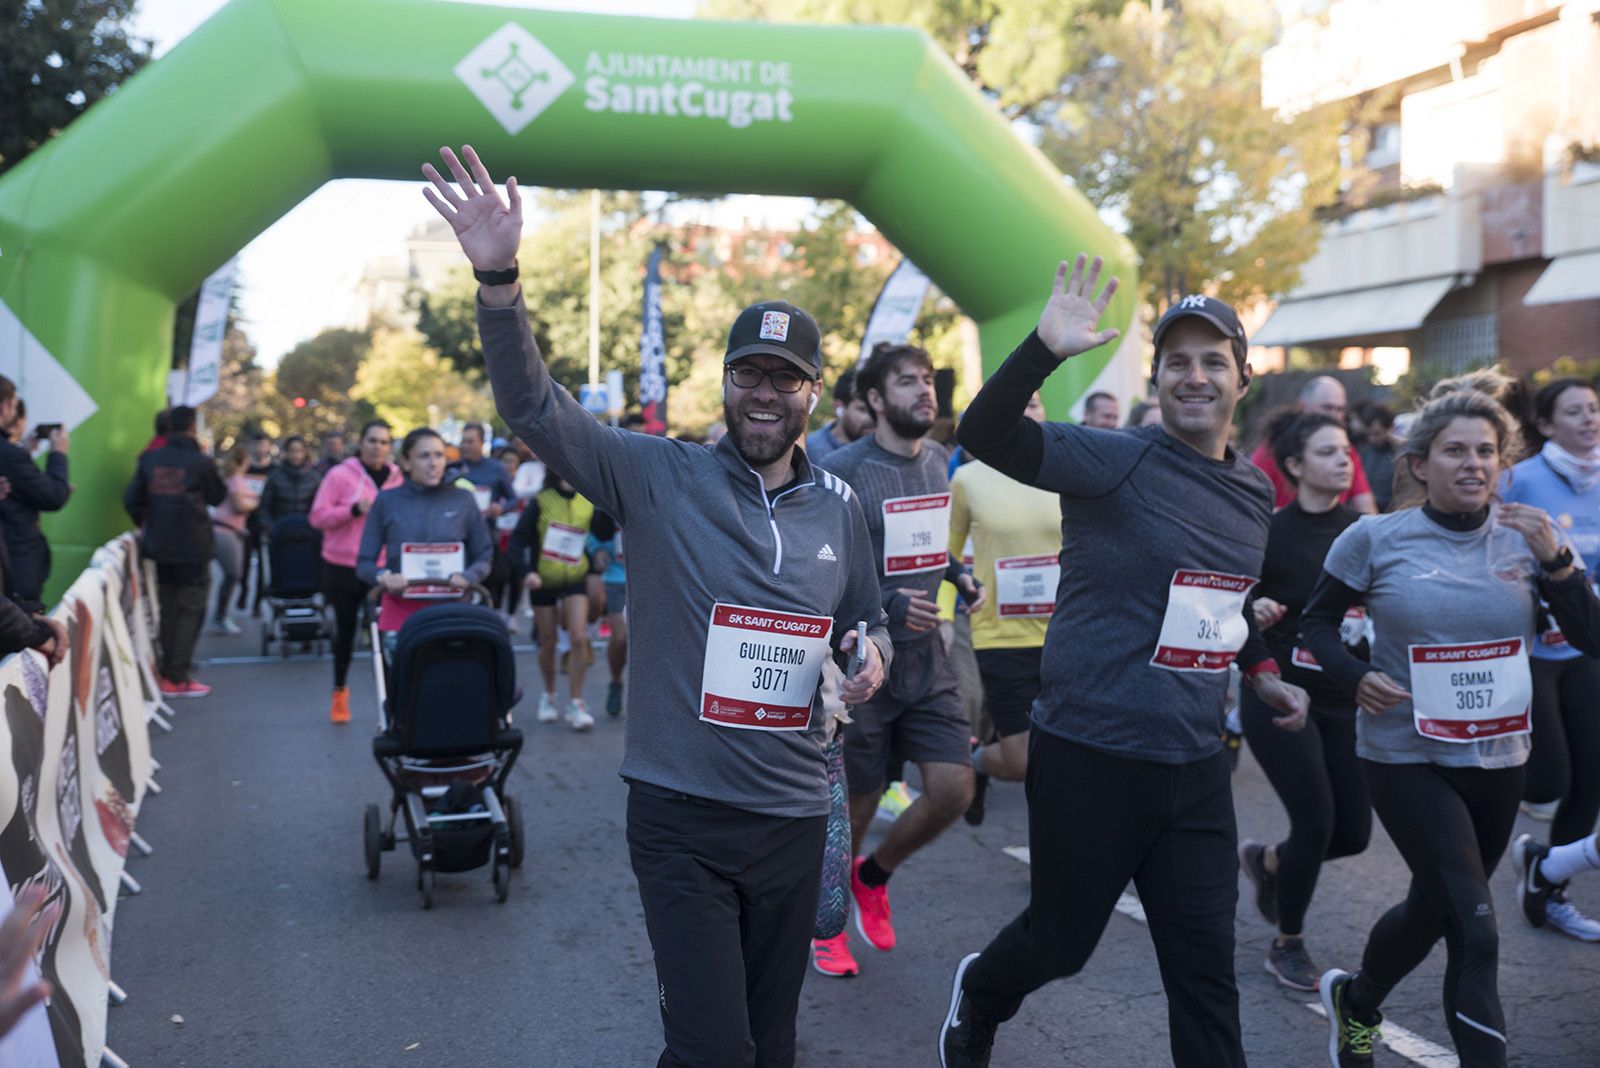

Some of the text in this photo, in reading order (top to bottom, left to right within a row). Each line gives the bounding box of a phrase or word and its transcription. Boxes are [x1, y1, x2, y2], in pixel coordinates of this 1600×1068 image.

[584, 50, 793, 86] AJUNTAMENT DE
[584, 76, 794, 128] SantCugat
[817, 553, 837, 562] adidas
[729, 614, 822, 634] 5K SANT CUGAT 22
[739, 641, 806, 665] GUILLERMO
[1438, 650, 1466, 660] SANT
[1466, 647, 1497, 658] CUGAT
[1497, 645, 1512, 655] 22
[752, 666, 789, 692] 3071
[1451, 670, 1495, 687] GEMMA
[1456, 689, 1494, 710] 3057
